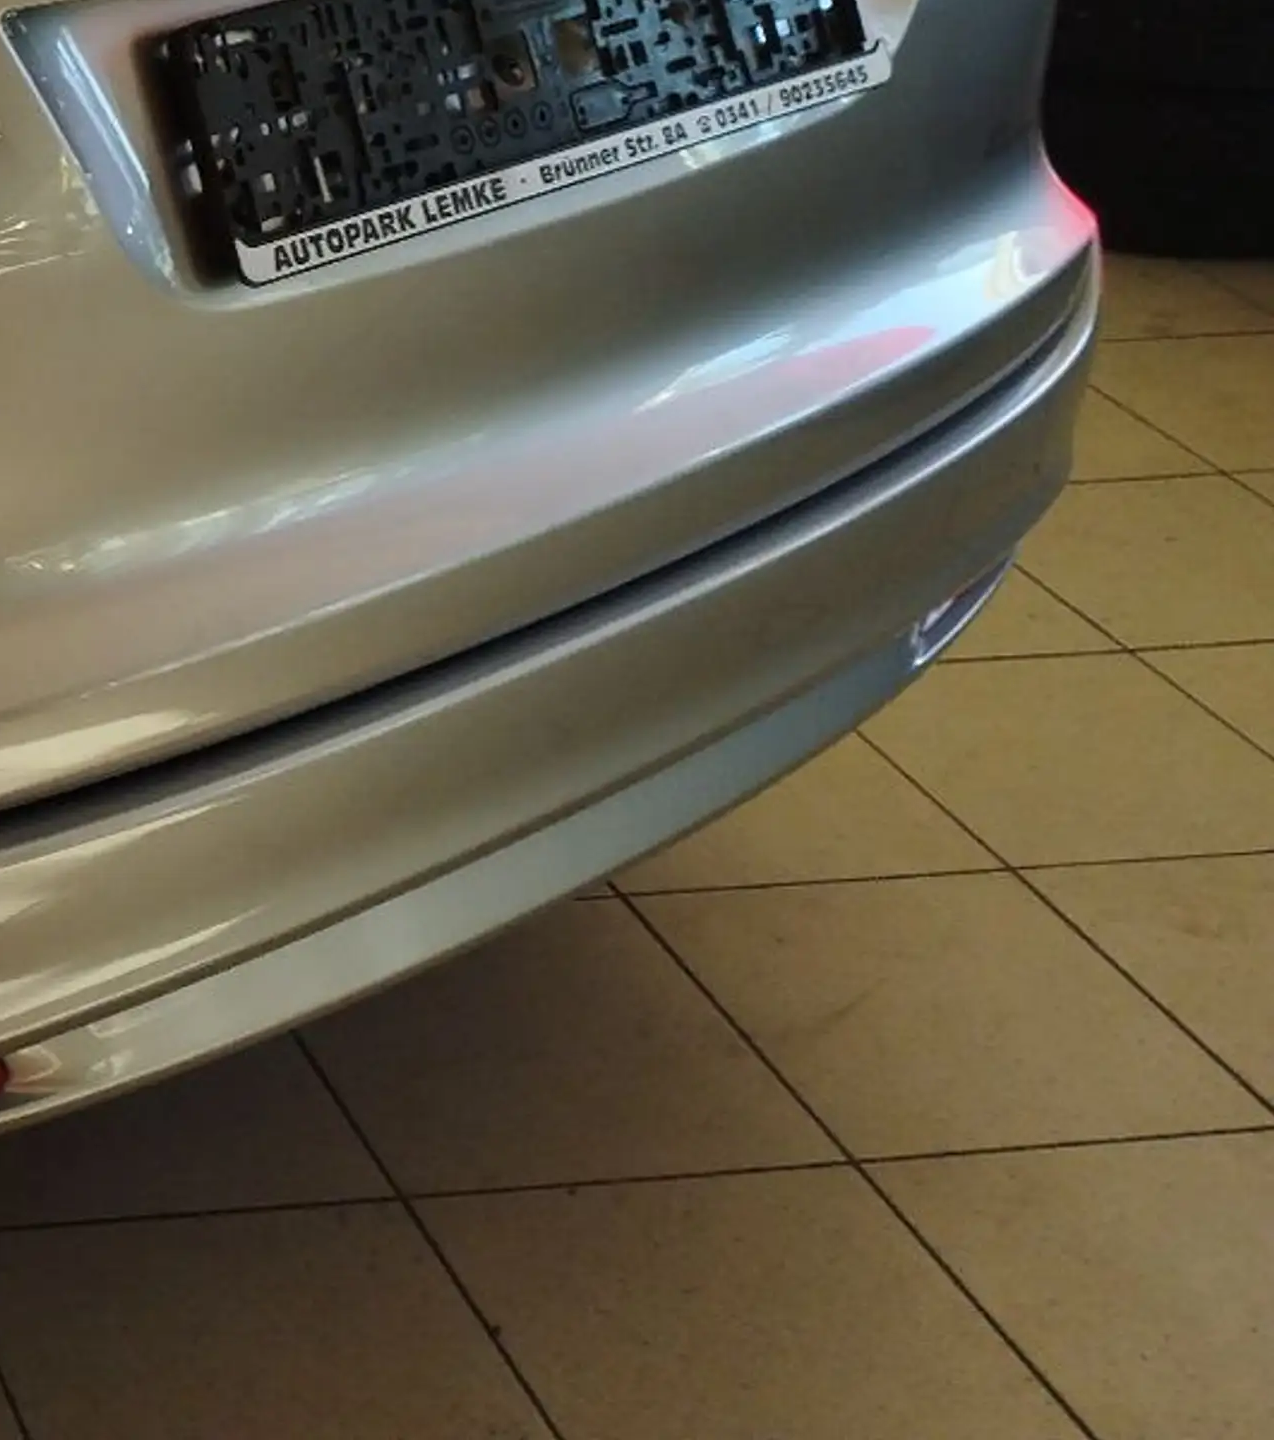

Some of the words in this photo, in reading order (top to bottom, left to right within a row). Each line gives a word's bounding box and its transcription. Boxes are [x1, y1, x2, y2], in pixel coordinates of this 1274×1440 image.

[273, 205, 417, 273] AUTOPARK
[421, 177, 508, 225] LEMKE
[624, 130, 660, 158] Str.
[715, 98, 759, 128] 0341
